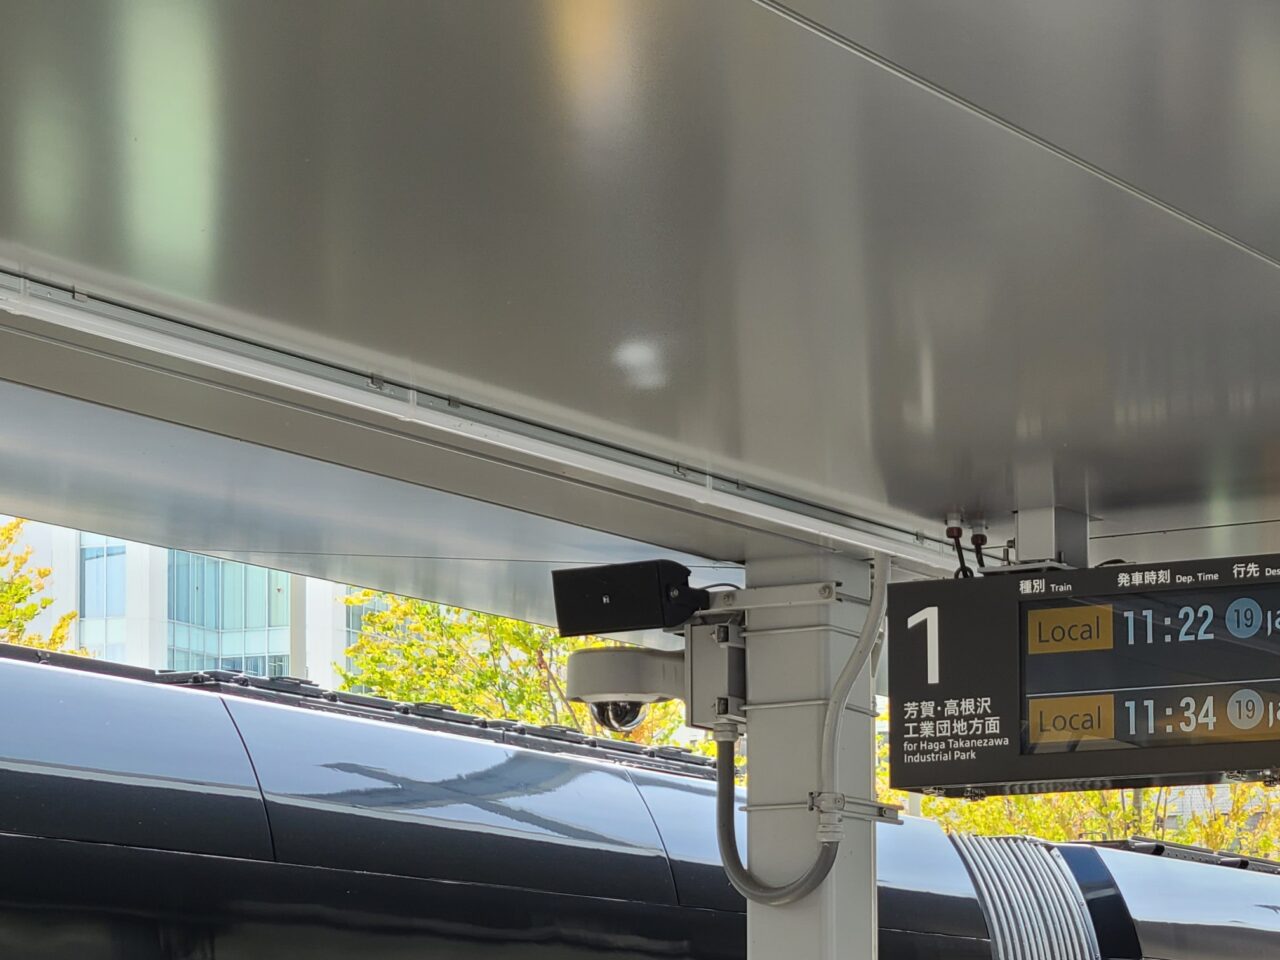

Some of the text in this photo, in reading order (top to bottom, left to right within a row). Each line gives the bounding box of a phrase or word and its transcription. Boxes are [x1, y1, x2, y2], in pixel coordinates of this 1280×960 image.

[1117, 569, 1219, 588] 発車時刻 Dep. Time
[1232, 562, 1260, 579] 行先
[1019, 579, 1072, 595] 種別 Train
[1038, 615, 1100, 645] Local
[1123, 604, 1215, 646] 11:22
[907, 605, 940, 685] 1
[903, 697, 992, 719] 芳賀・高根沢
[1039, 706, 1101, 734] Local
[1125, 696, 1217, 736] 11:34
[904, 716, 1000, 738] 工業団地方面
[903, 737, 1009, 752] for Haga Takanezawa
[904, 750, 977, 763] Industrial Park
